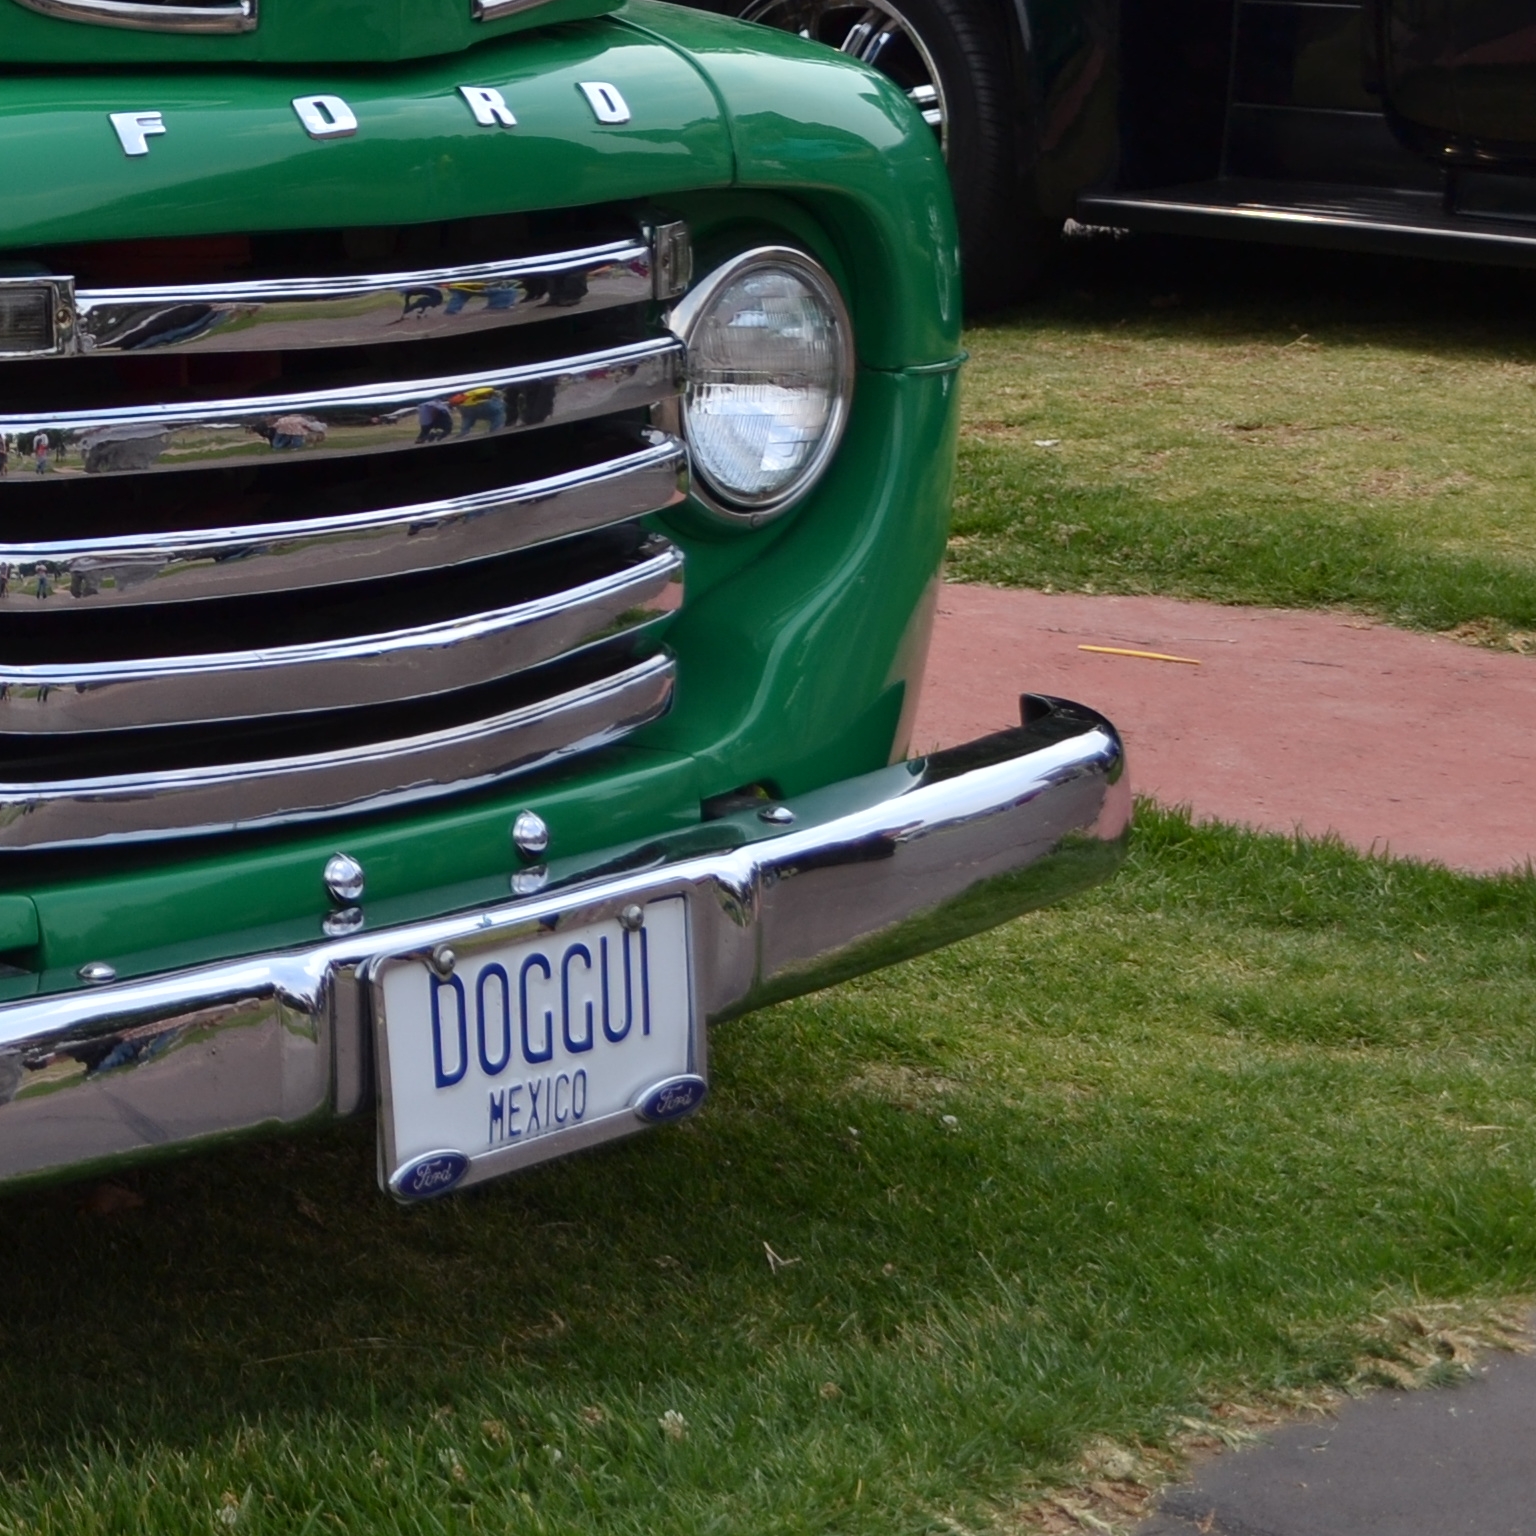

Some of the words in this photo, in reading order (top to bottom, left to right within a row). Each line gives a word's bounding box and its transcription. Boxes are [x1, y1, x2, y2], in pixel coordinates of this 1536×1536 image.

[107, 81, 632, 157] FORD
[429, 926, 651, 1089] DOGGUI
[488, 1068, 588, 1145] MEXICO
[656, 1084, 693, 1114] Ford
[413, 1159, 452, 1189] Ford
